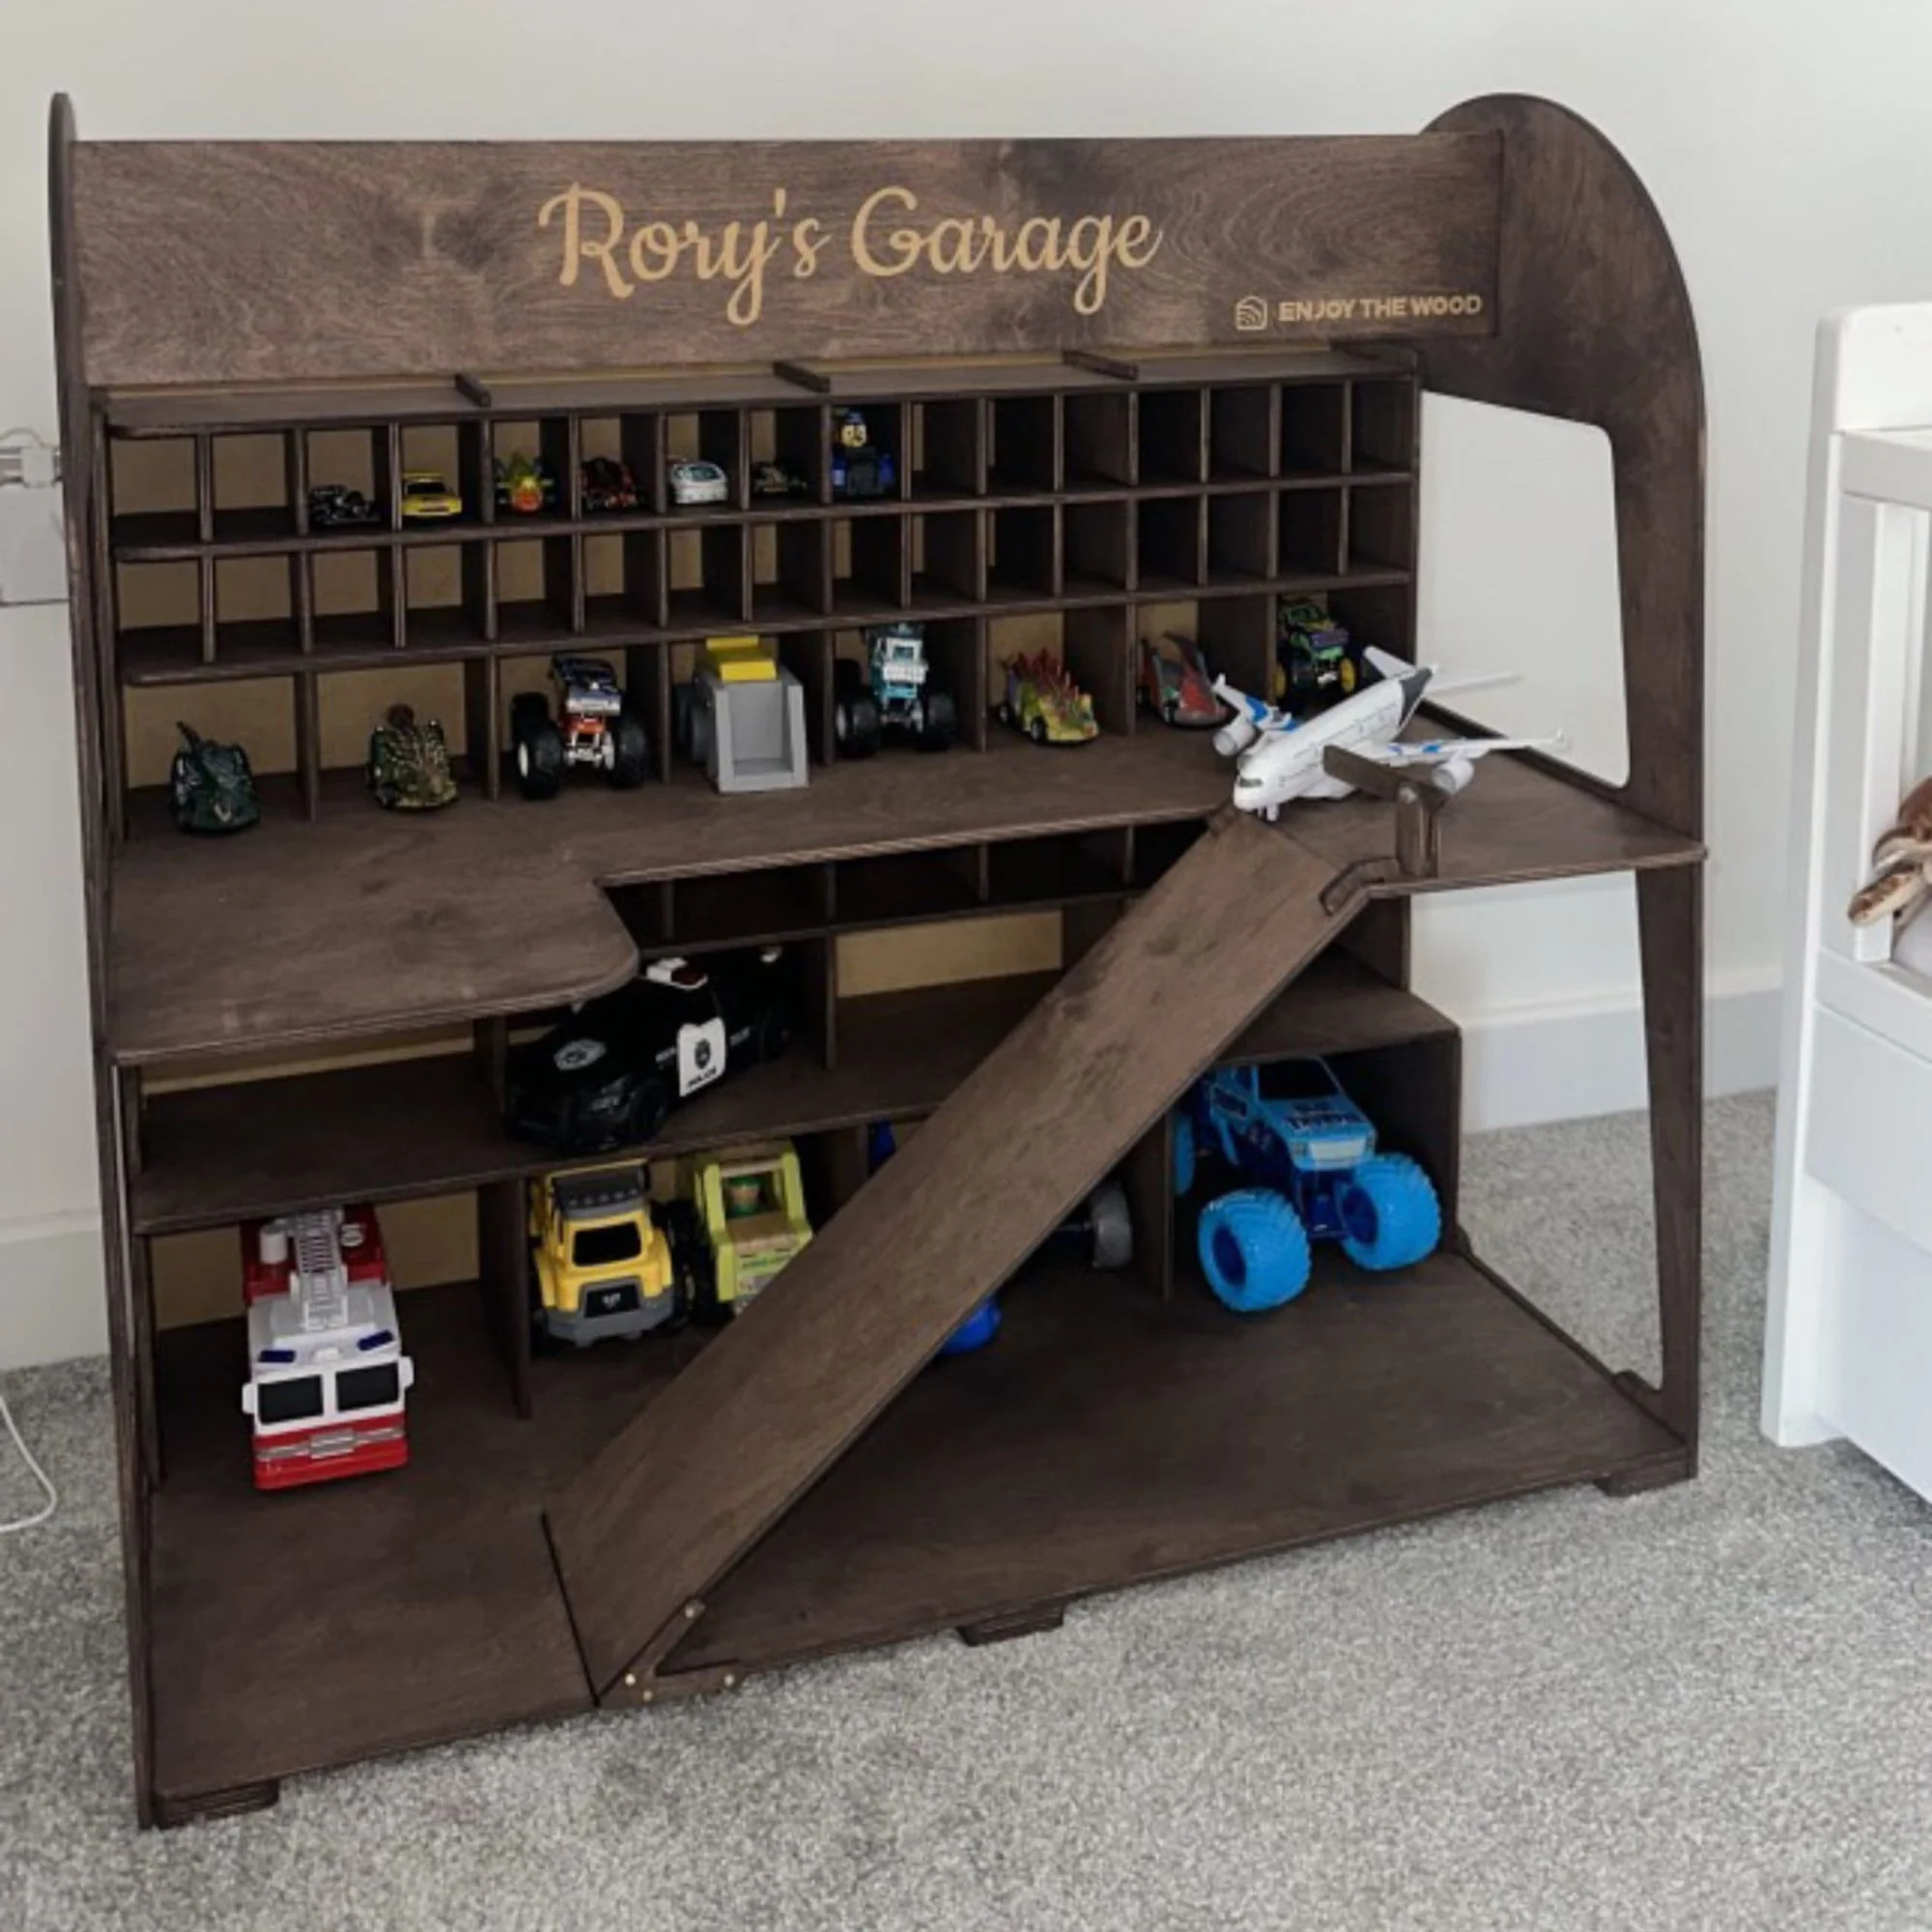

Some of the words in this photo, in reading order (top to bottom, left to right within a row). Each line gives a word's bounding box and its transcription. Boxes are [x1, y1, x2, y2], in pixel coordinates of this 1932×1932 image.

[538, 182, 832, 326] Rory's
[850, 185, 1163, 315] Garage
[1278, 298, 1355, 322] ENJOY
[1359, 297, 1407, 319] THE
[1410, 293, 1483, 317] WOOD
